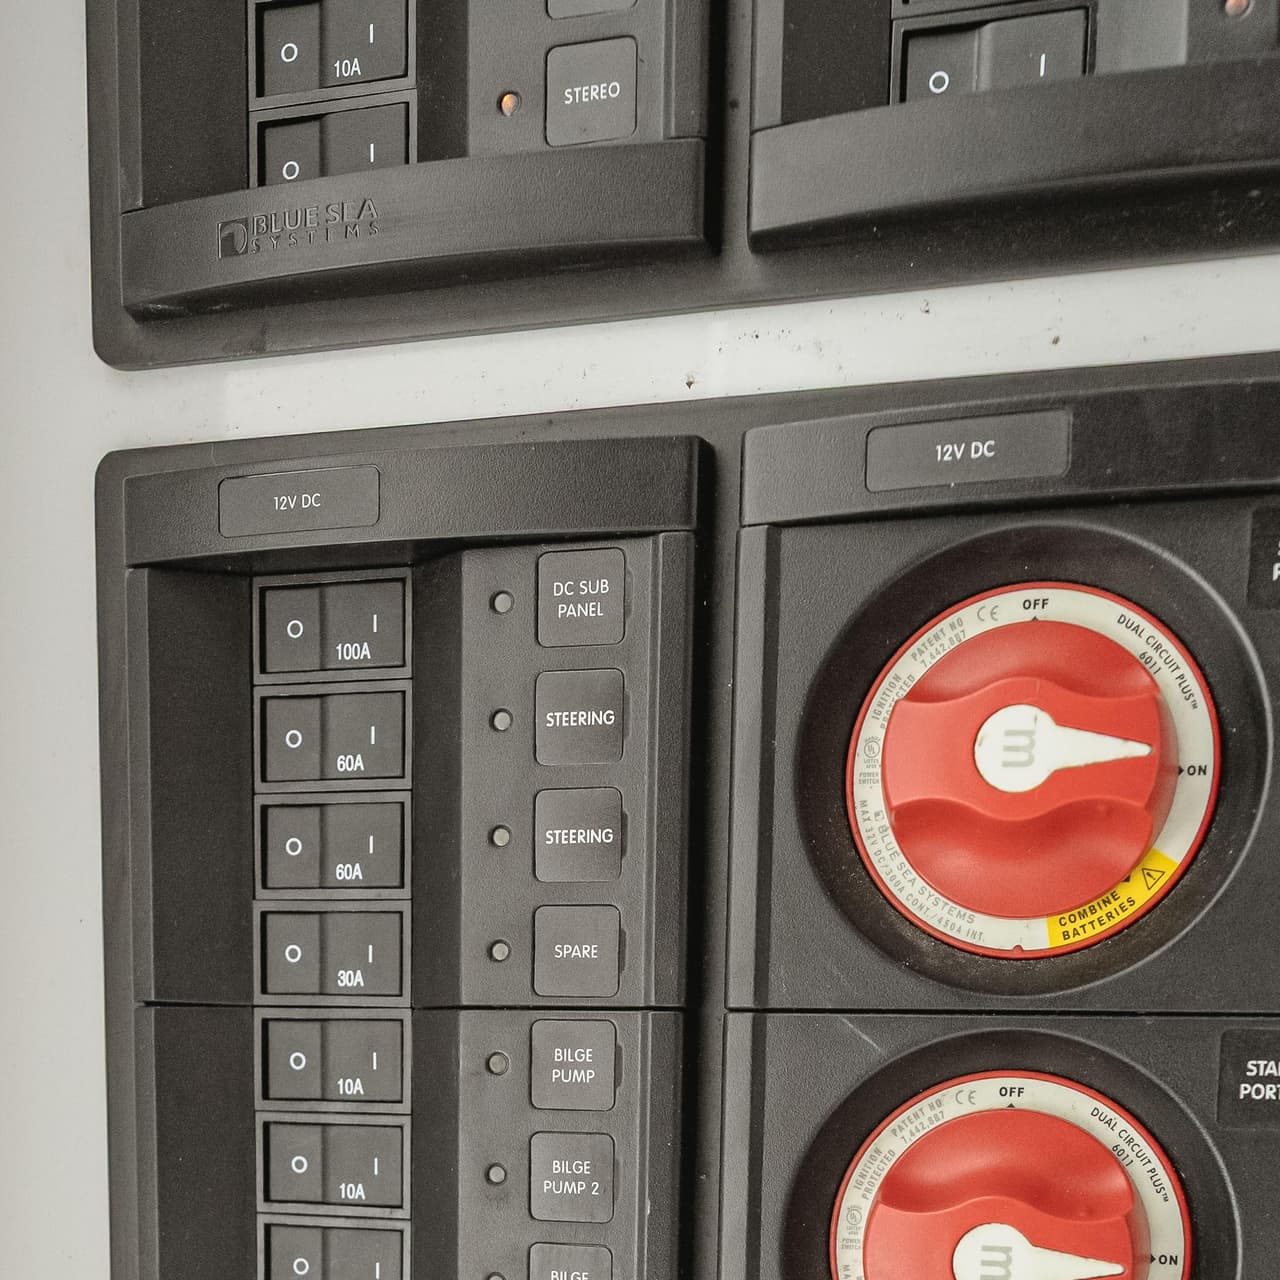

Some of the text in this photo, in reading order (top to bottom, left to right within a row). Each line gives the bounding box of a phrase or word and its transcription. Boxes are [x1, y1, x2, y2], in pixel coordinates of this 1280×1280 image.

[333, 57, 362, 78] 10A
[564, 81, 621, 105] STEREO
[252, 205, 320, 237] BLUE
[935, 440, 995, 462] 12V DC
[273, 492, 321, 510] 12V DC
[553, 578, 610, 597] DC SUB
[558, 601, 604, 619] PANEL
[1022, 599, 1049, 611] OFF
[335, 641, 372, 661] 100A
[911, 628, 947, 662] PATENT
[1116, 612, 1147, 640] DUAL
[1145, 634, 1182, 674] CIRCUIT
[1138, 650, 1163, 675] 6011
[871, 673, 902, 721] IGNITION
[545, 709, 615, 727] STEERING
[336, 753, 365, 772] 60A
[1187, 764, 1208, 777] ON
[545, 828, 614, 845] STEERING
[335, 862, 363, 881] 60A
[877, 824, 977, 924] BLUE SEA SYSTEMS
[1058, 890, 1121, 927] COMBINE
[1061, 896, 1136, 941] BATTERIES
[554, 944, 598, 959] SPARE
[337, 969, 365, 987] 30A
[554, 1047, 593, 1063] BILGE
[552, 1068, 596, 1083] PUMP
[337, 1077, 364, 1095] 10A
[999, 1086, 1025, 1098] OFF
[1089, 1106, 1118, 1132] DUAL
[1118, 1128, 1153, 1168] CIRCUIT
[1111, 1144, 1135, 1168] 6011
[552, 1159, 591, 1175] BILGE
[861, 1148, 896, 1201] PROTECTED
[339, 1182, 366, 1201] 10A
[543, 1180, 600, 1196] PUMP 2
[1158, 1254, 1179, 1266] ON
